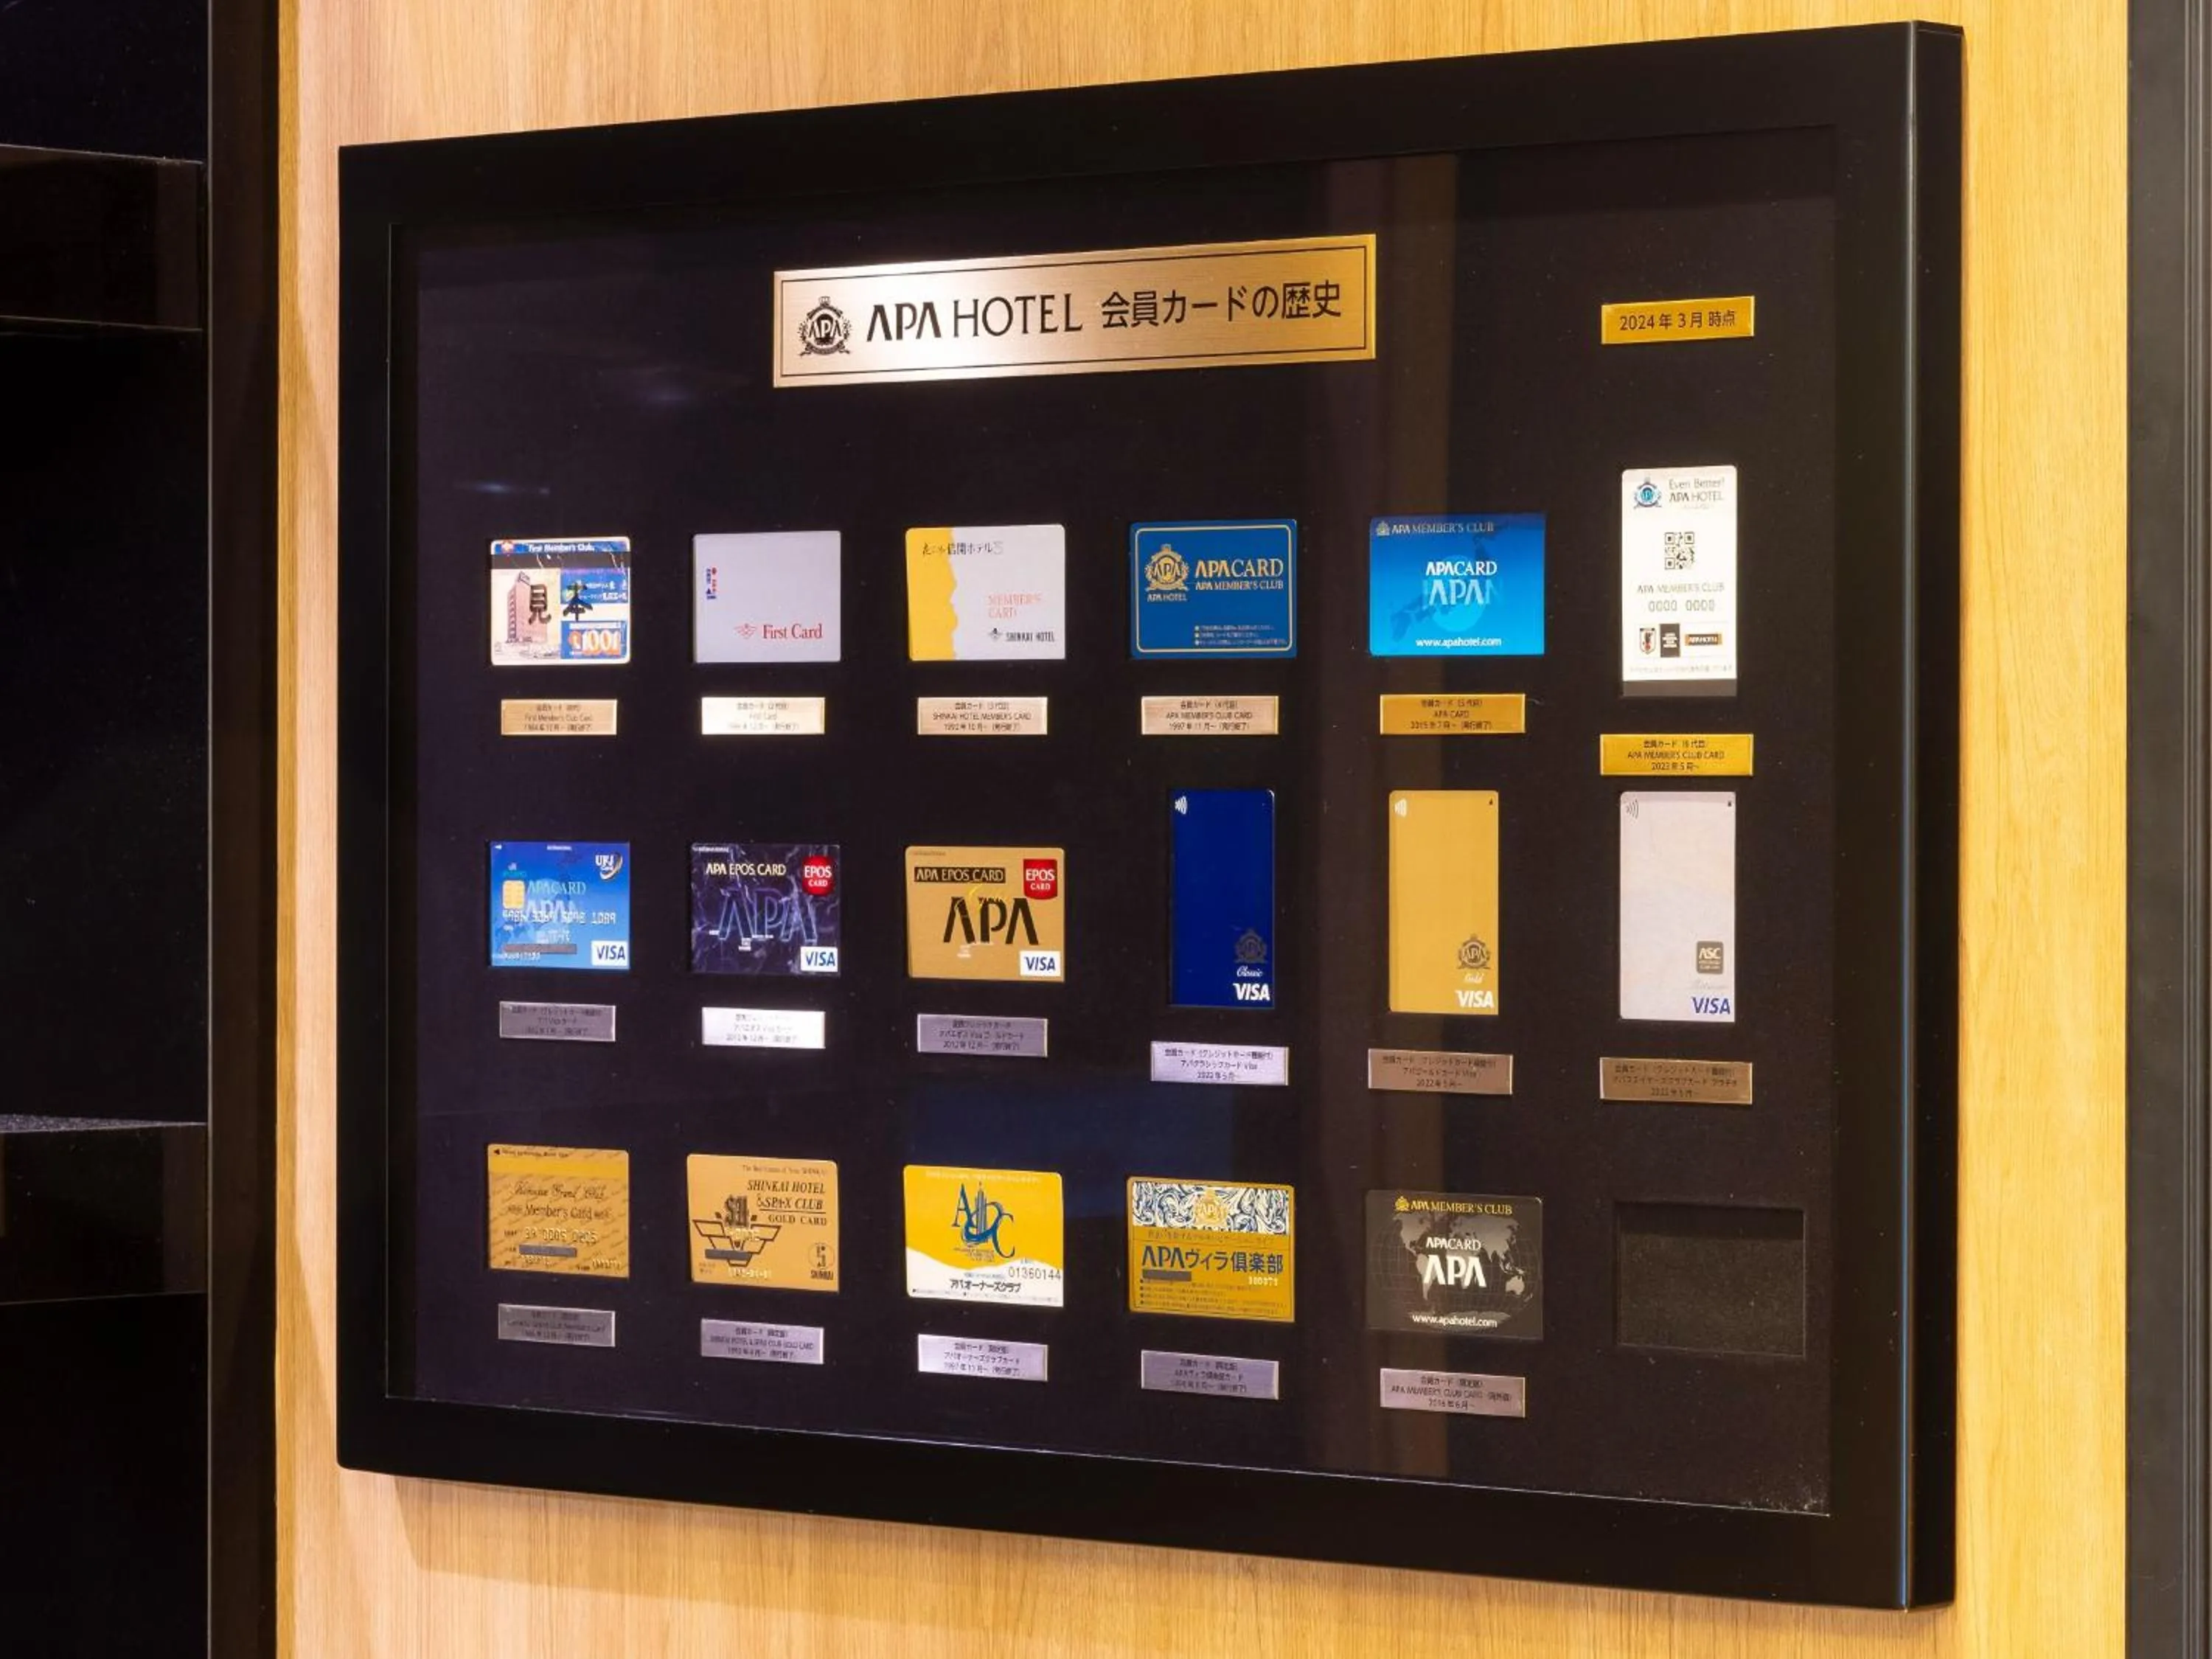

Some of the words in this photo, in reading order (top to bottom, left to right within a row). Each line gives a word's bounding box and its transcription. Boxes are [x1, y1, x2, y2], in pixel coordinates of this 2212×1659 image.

[866, 301, 942, 342] APA
[952, 293, 1083, 337] HOTEL
[1102, 279, 1341, 329] 会員カードの歴史
[1669, 492, 1689, 502] APA
[1691, 490, 1723, 502] HOTEL
[1391, 524, 1410, 535] APA
[1411, 523, 1464, 534] MEMBER'S
[1466, 522, 1495, 532] CLUB
[1425, 560, 1498, 576] APACARD
[1259, 580, 1284, 590] CLUB
[1701, 582, 1725, 592] CLUB
[762, 625, 787, 639] First
[791, 623, 823, 639] Card
[1415, 637, 1502, 649] www.apahotel.com
[706, 863, 728, 875] APA
[729, 863, 756, 876] EPOS
[757, 863, 787, 876] CARD
[804, 866, 832, 879] EPOS
[916, 869, 939, 881] APA
[942, 869, 970, 882] EPOS
[973, 869, 1004, 883] CARD
[1025, 869, 1056, 882] EPOS
[1029, 882, 1051, 891] CARD
[943, 897, 1040, 945] APA
[596, 945, 627, 961] VISA
[805, 952, 836, 967] VISA
[1699, 947, 1722, 959] ASC
[1024, 956, 1056, 971] VISA
[1232, 983, 1270, 1001] VISA
[1455, 990, 1495, 1009] VISA
[1692, 997, 1731, 1015] VISA
[747, 1180, 790, 1193] SHINKAI
[792, 1182, 826, 1194] HOTEL
[794, 1198, 824, 1210] CLUB
[1411, 1200, 1430, 1211] APA
[1430, 1202, 1484, 1214] MEMBER'S
[1484, 1205, 1513, 1215] CLUB
[524, 1204, 568, 1220] Member's
[571, 1208, 593, 1221] Card
[768, 1214, 796, 1224] GOLD
[800, 1217, 827, 1227] CARD
[1426, 1237, 1481, 1252] APACARD
[1423, 1253, 1487, 1289] APA
[950, 1279, 1022, 1293] アパオーナーズクラブ
[1412, 1315, 1498, 1329] www.apahotel.com
